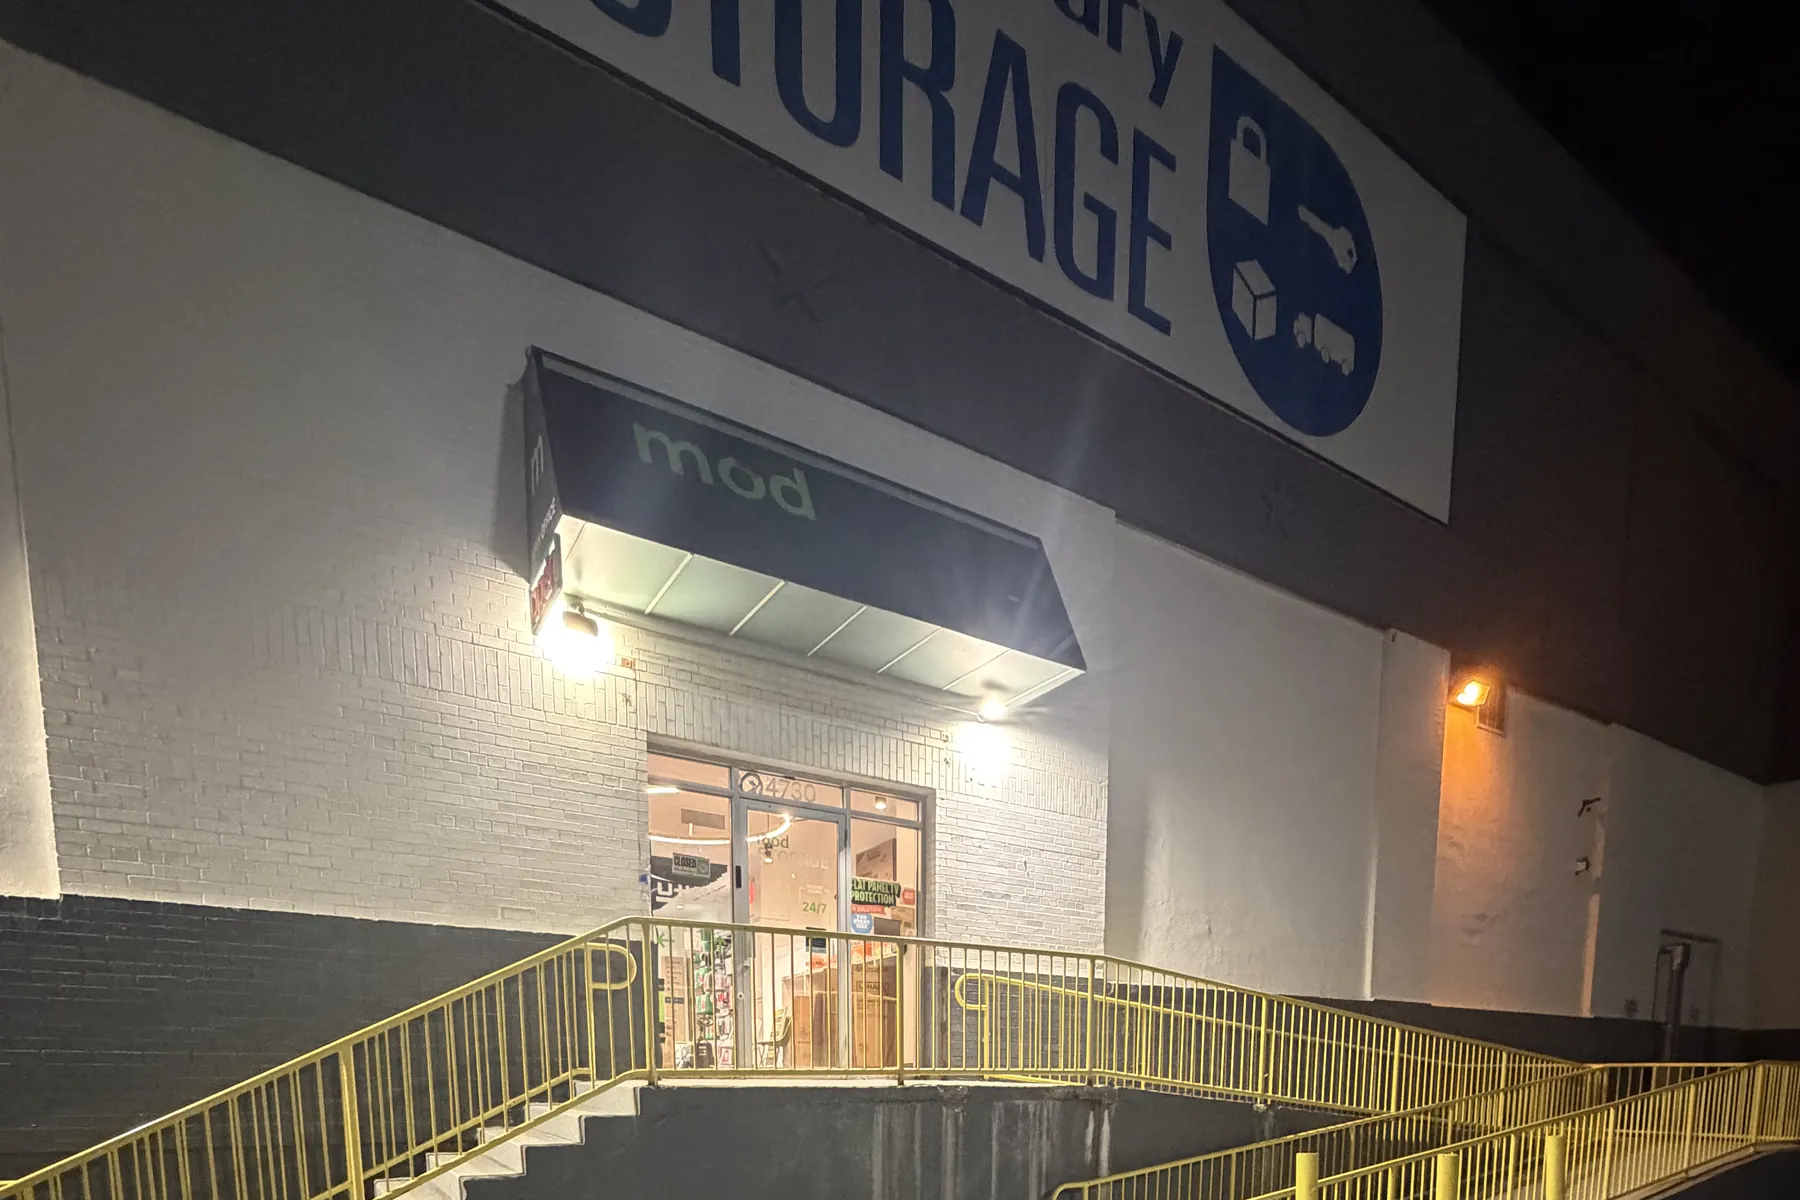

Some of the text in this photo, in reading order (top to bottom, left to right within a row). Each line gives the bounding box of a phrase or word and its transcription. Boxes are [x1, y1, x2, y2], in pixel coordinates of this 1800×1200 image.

[589, 0, 1177, 336] ORAGE
[633, 421, 817, 521] mod
[766, 775, 817, 804] 4730
[673, 855, 697, 868] CLOSED
[802, 901, 827, 914] 24/7
[850, 890, 894, 904] PROTECTION
